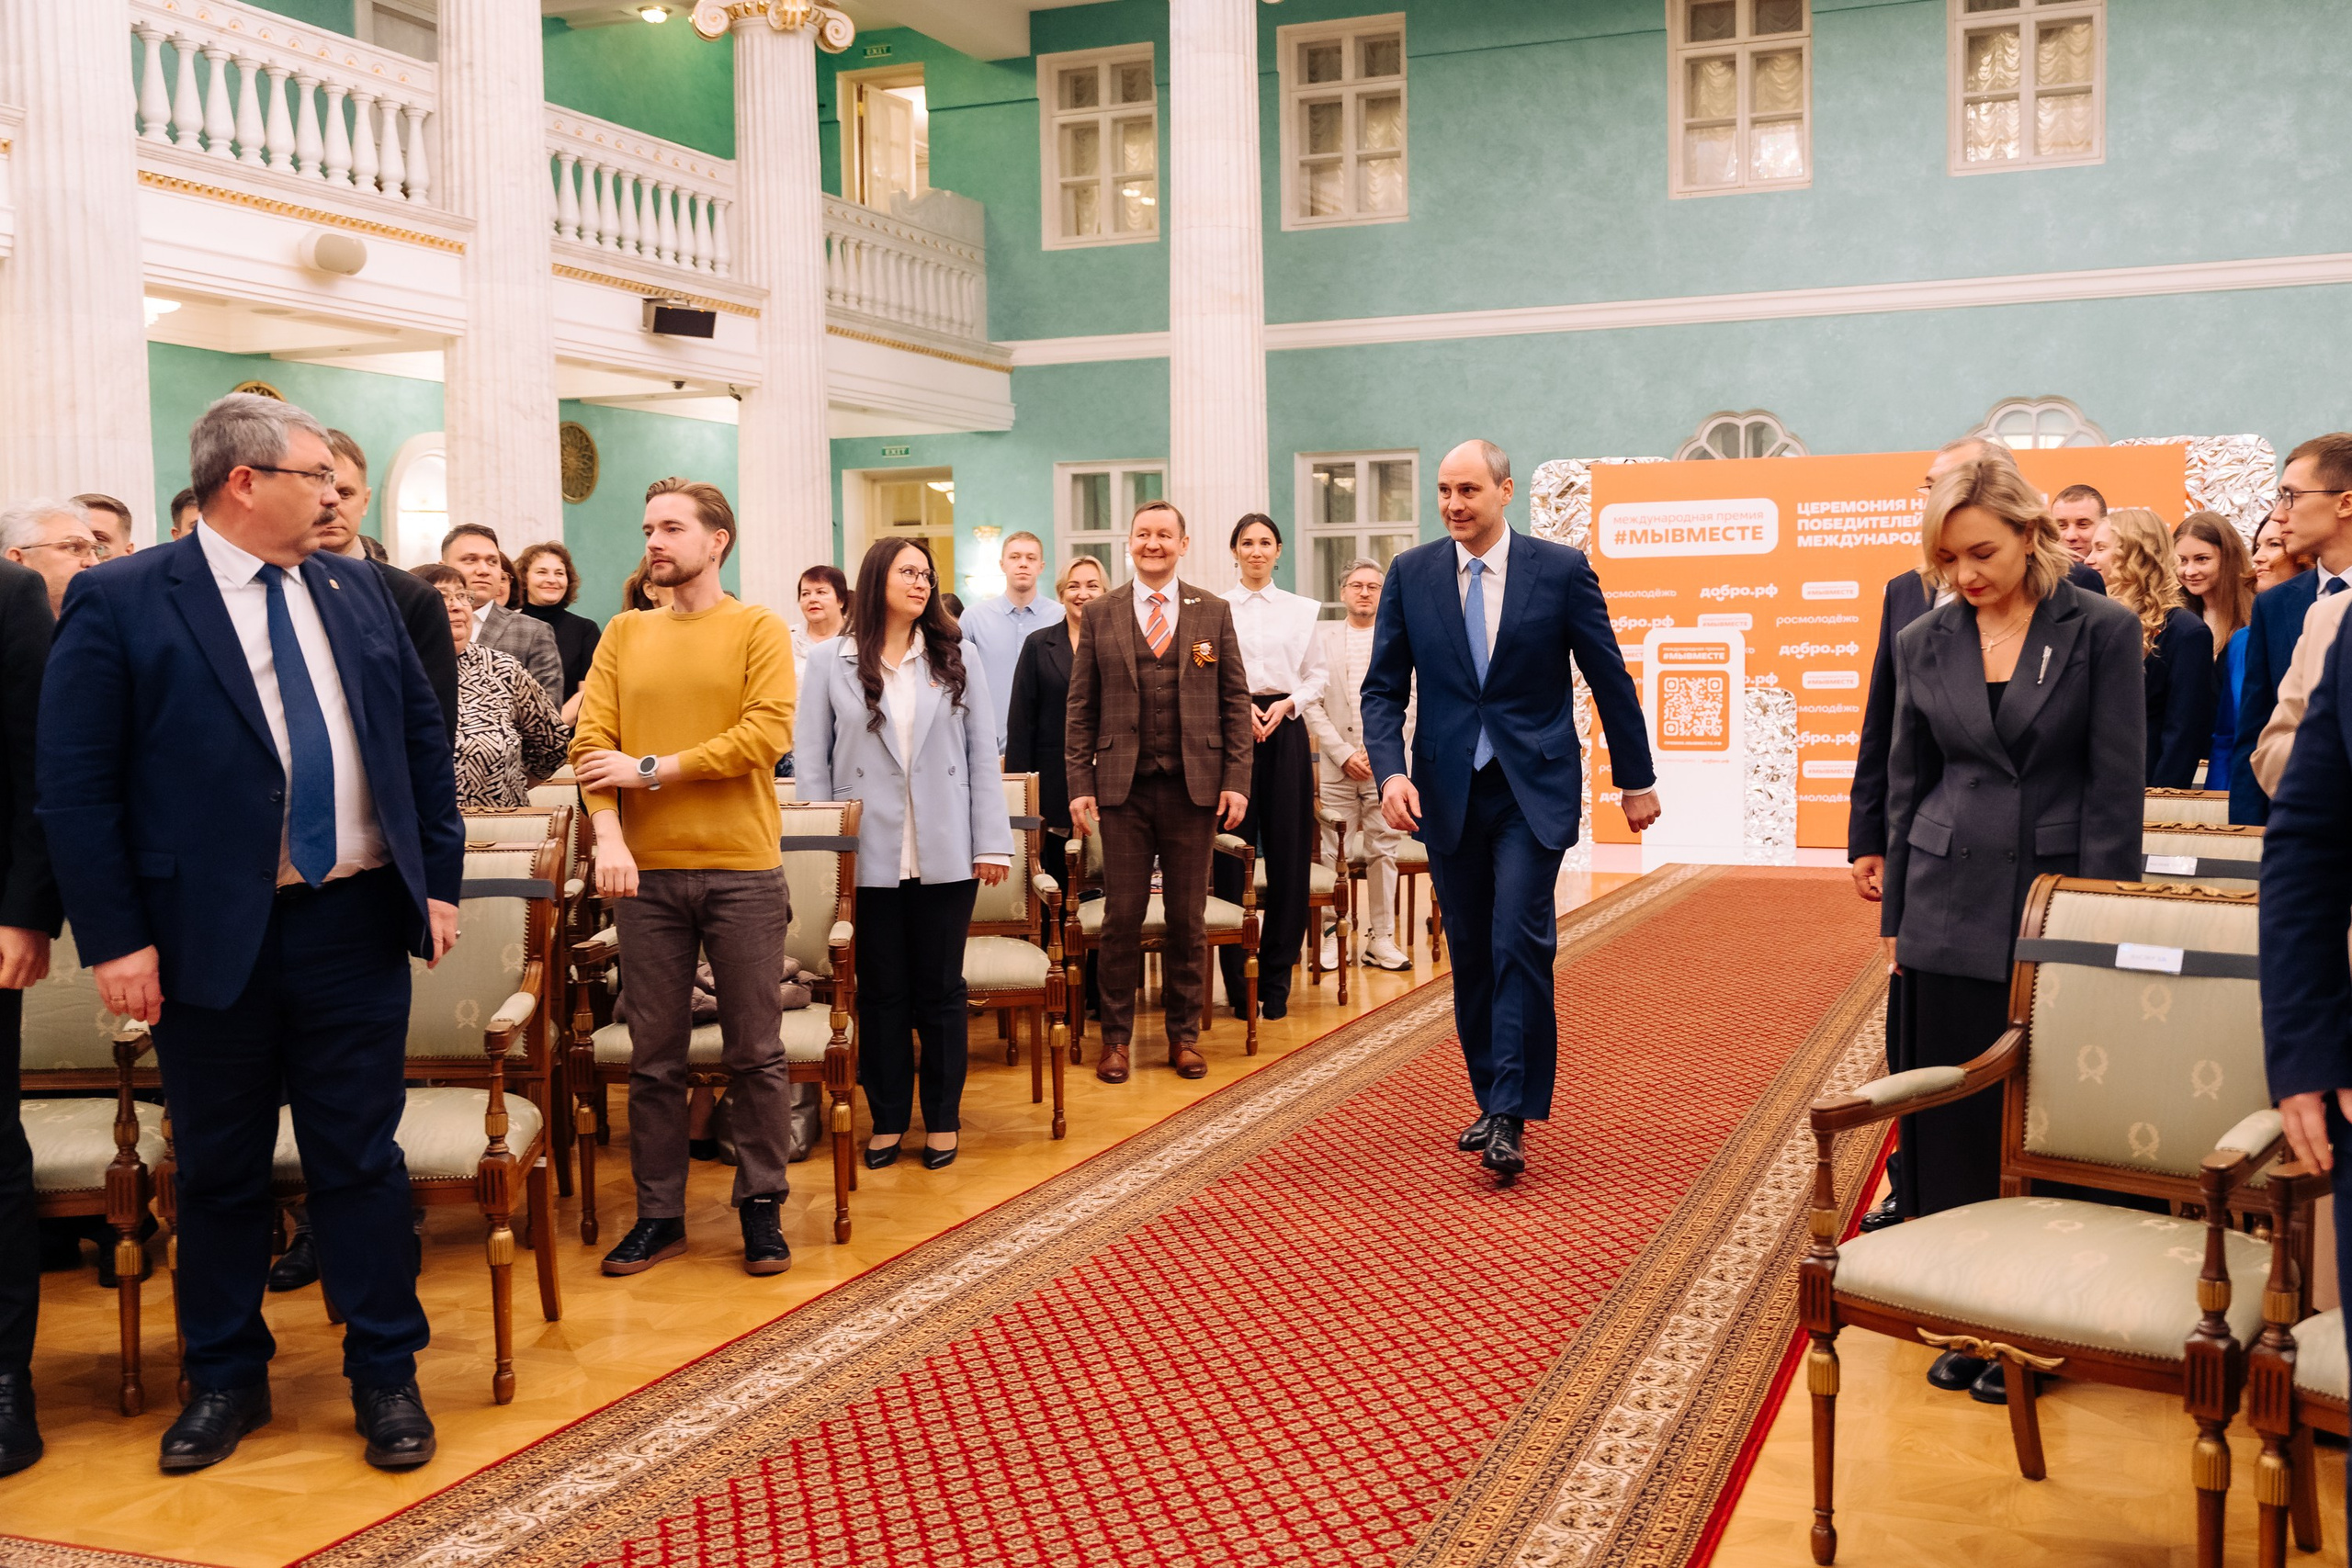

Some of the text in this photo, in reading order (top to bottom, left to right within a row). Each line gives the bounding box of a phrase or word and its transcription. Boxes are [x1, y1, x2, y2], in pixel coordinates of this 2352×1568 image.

[1797, 499, 1906, 516] ЦЕРЕМОНИЯ
[1613, 511, 1764, 526] международная премия
[1797, 512, 1924, 532] ПОБЕДИТЕЛЕЙ
[1613, 525, 1764, 546] #МЫВМЕСТЕ
[1797, 532, 1923, 548] МЕЖДУНАРОД
[1700, 583, 1779, 600] добро.рф
[1610, 615, 1675, 630] обро.рф
[1776, 614, 1859, 627] росмолодёжь
[1779, 641, 1860, 658] добро.рф
[1796, 704, 1860, 714] молодёжь
